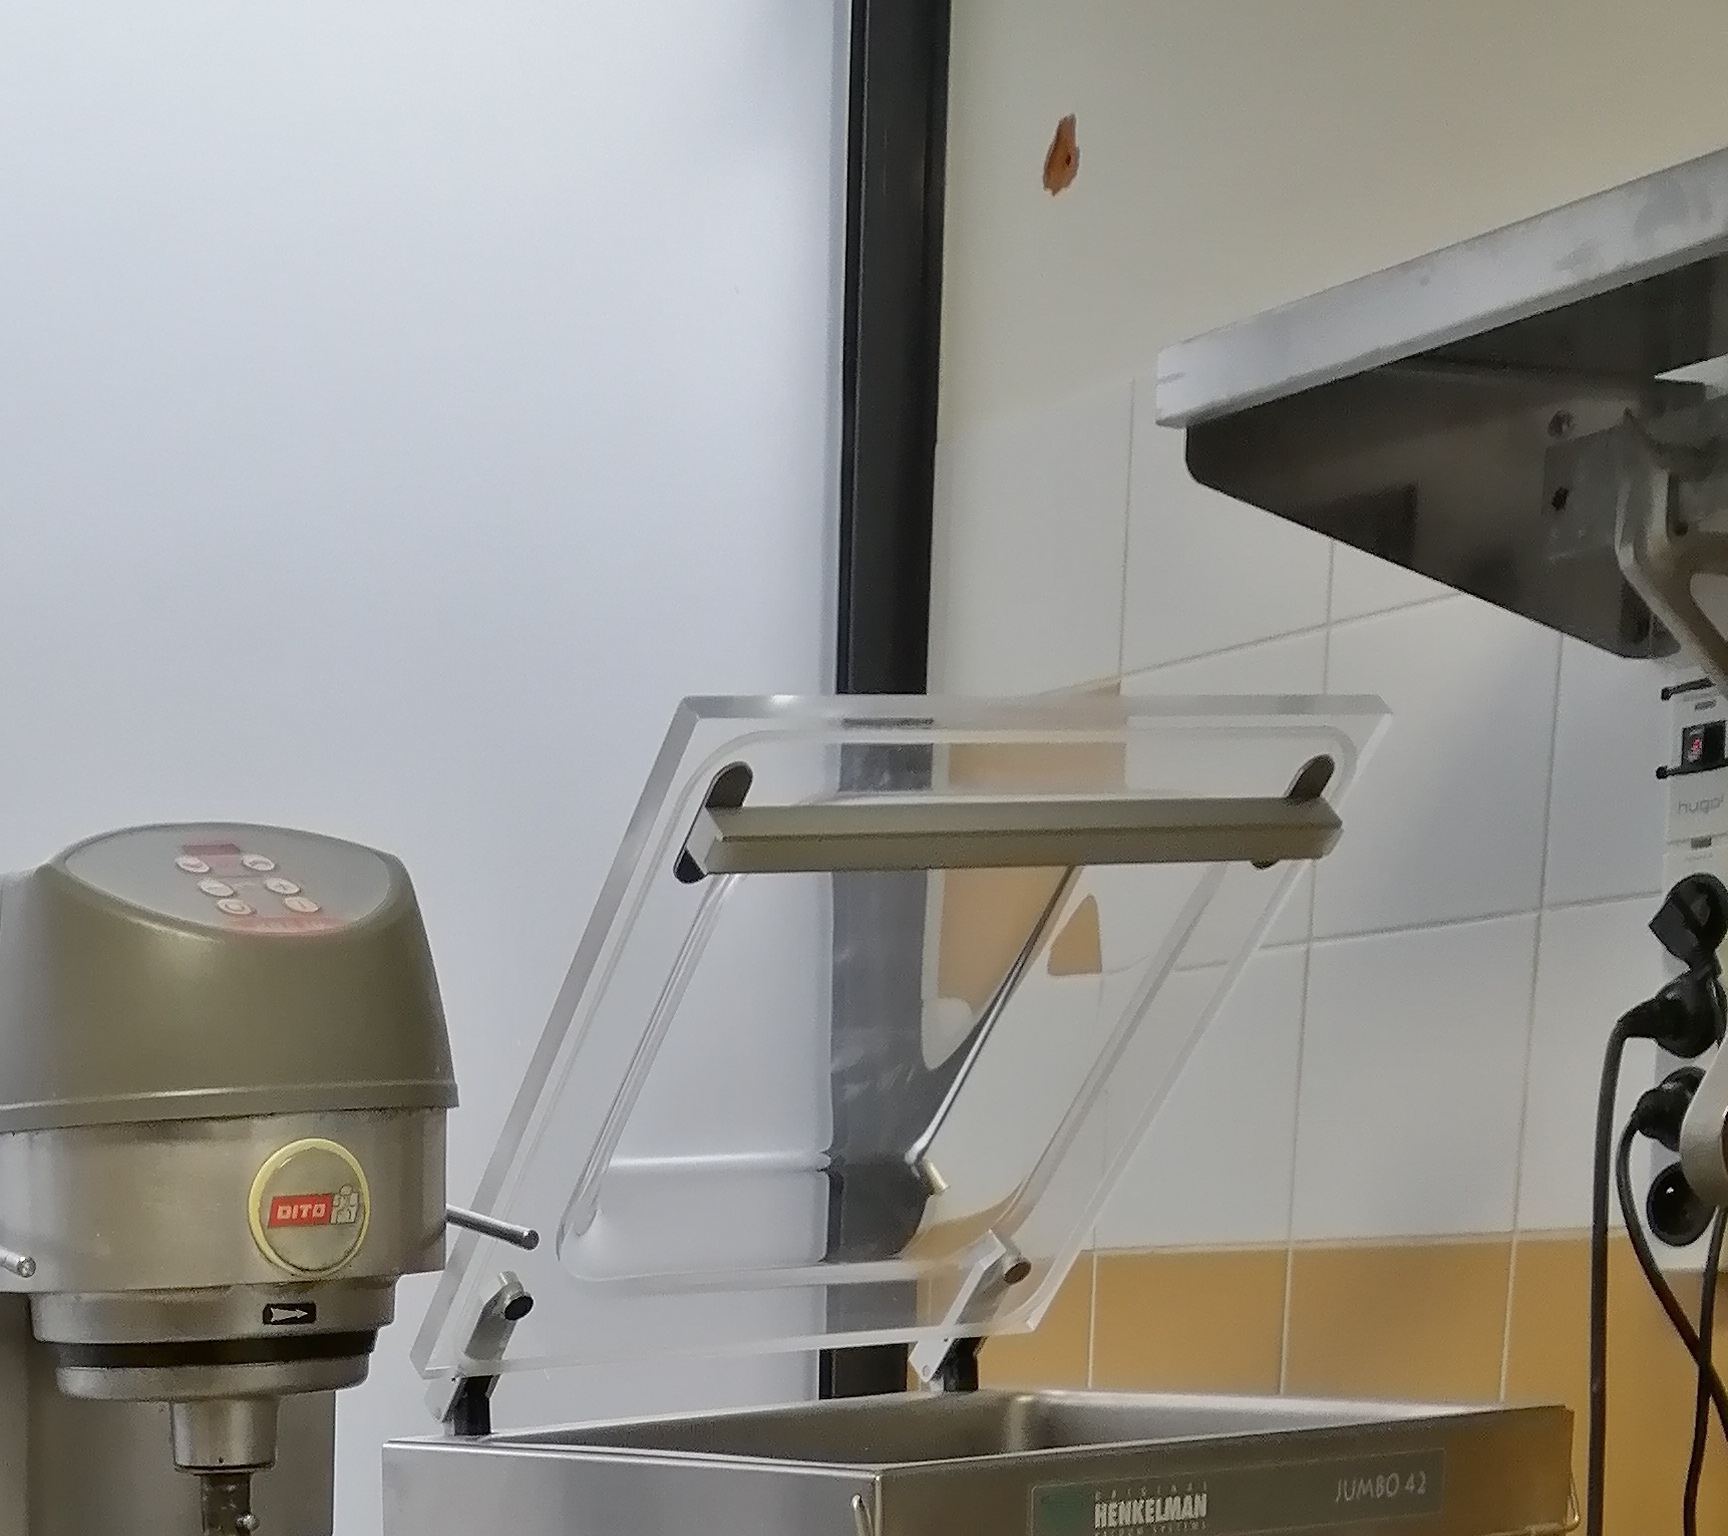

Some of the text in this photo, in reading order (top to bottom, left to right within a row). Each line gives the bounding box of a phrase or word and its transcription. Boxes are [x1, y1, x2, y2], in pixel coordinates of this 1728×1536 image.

[276, 1203, 327, 1220] DITO
[1335, 1472, 1400, 1503] JUMBO
[1094, 1493, 1208, 1529] HENKELMAN
